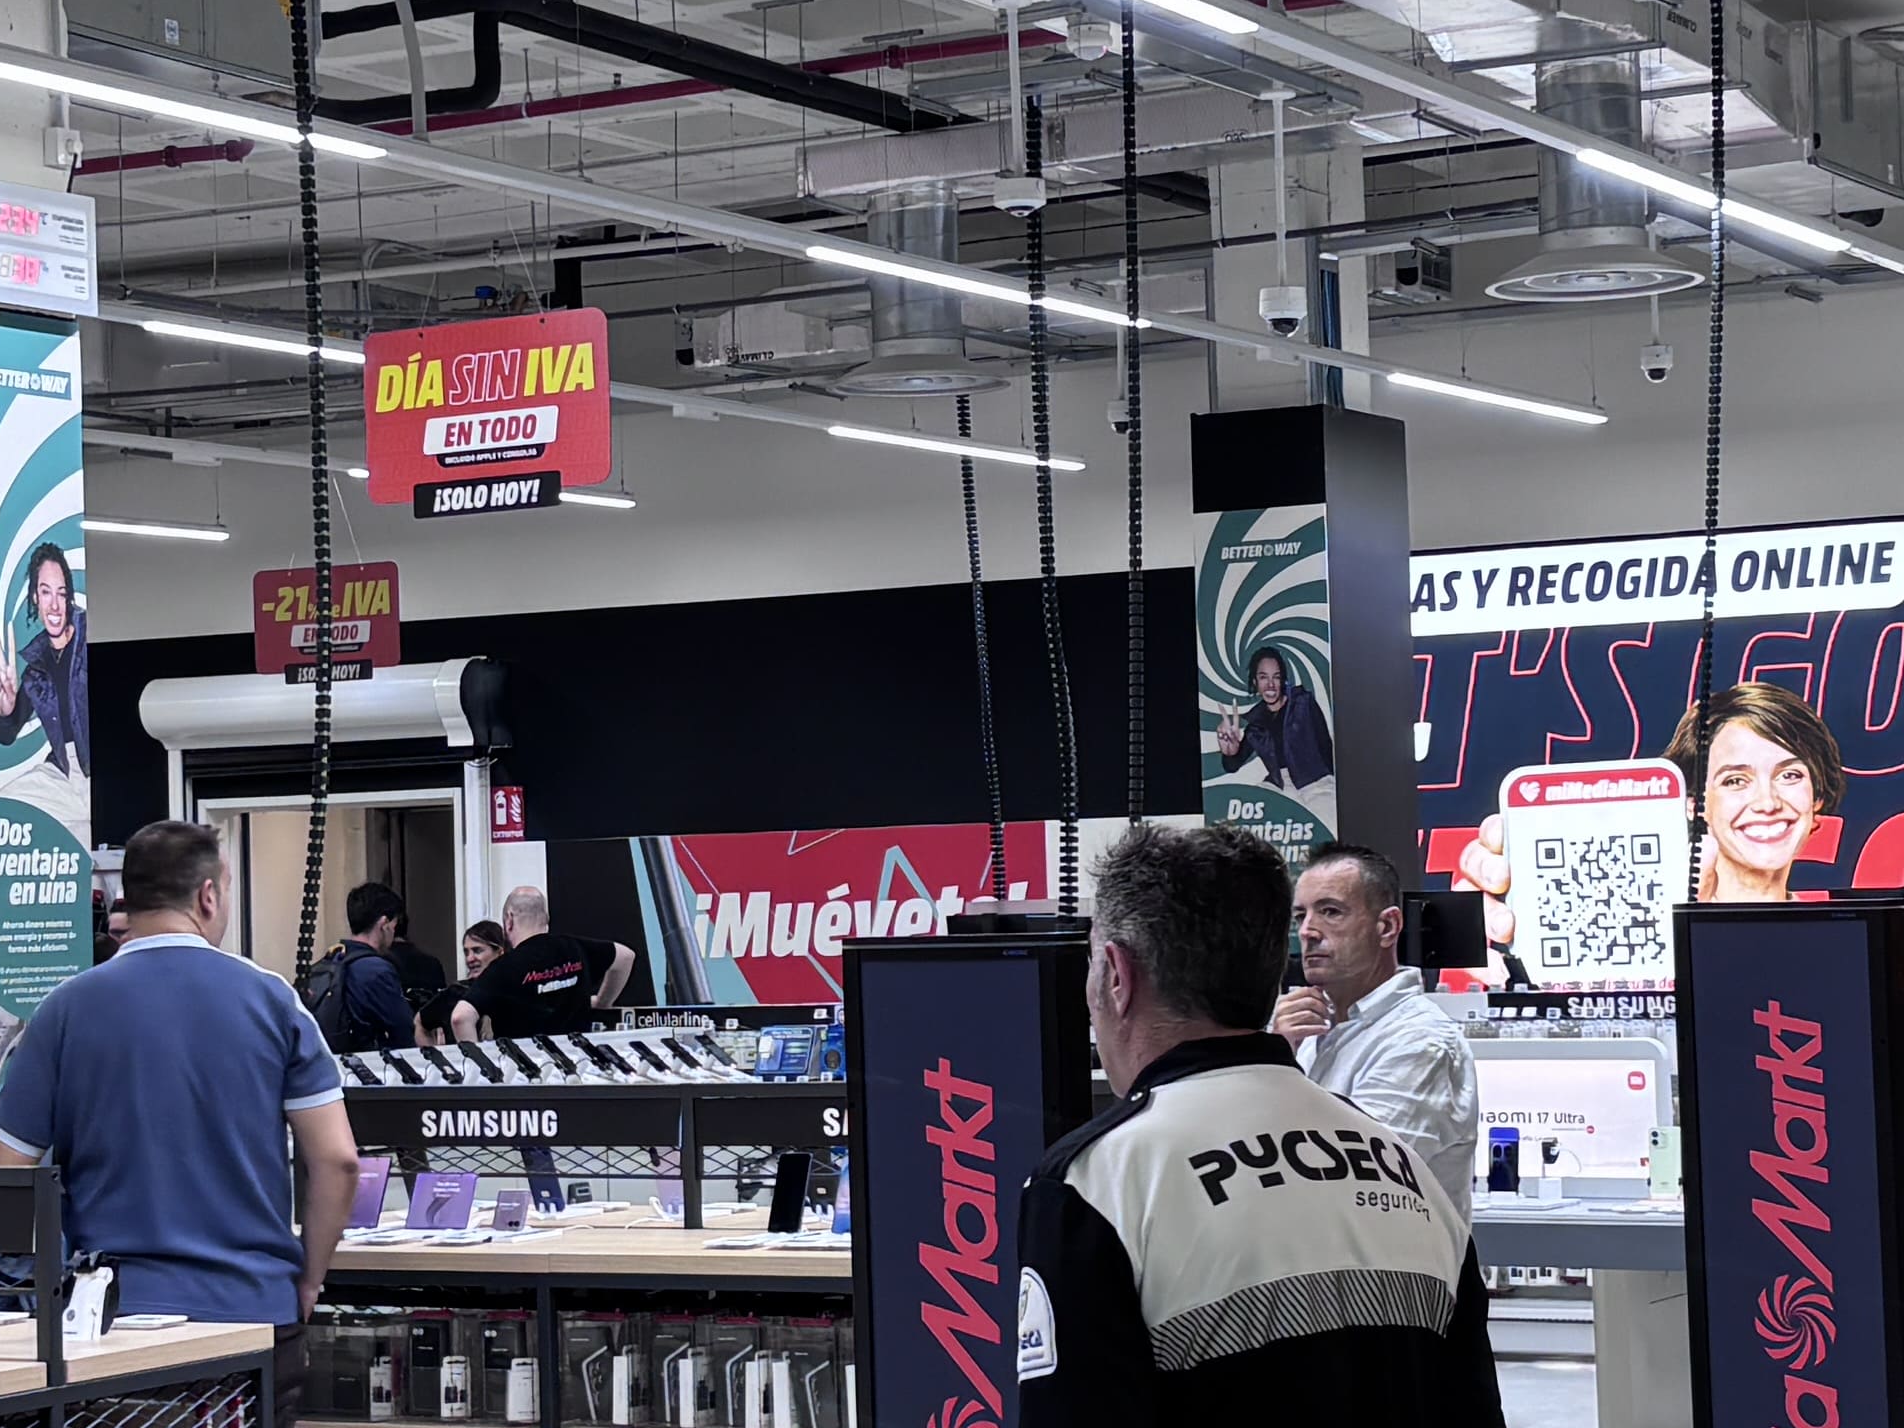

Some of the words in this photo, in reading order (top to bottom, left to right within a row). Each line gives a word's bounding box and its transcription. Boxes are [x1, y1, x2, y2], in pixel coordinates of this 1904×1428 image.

[41, 374, 69, 394] WAY
[375, 352, 444, 413] DÍA
[449, 349, 521, 406] SIN
[523, 342, 595, 397] IVA
[444, 419, 473, 447] EN
[479, 414, 538, 444] TODO
[433, 483, 488, 513] ¡SOLO
[491, 479, 540, 507] HOY!
[1221, 543, 1264, 560] BETTER
[1274, 541, 1302, 558] WAY
[1473, 567, 1498, 608] Y
[1506, 554, 1718, 607] RECOGIDA
[1732, 541, 1897, 593] ONLINE
[342, 579, 392, 618] IVA
[327, 624, 359, 642] ODO
[331, 663, 360, 680] HOY!
[1544, 776, 1671, 803] miMediaMarkt
[1227, 799, 1265, 820] Dos
[1234, 819, 1314, 844] ntajas
[9, 884, 37, 905] en
[39, 879, 77, 904] una
[695, 881, 1028, 959] ¡Muévet
[637, 1010, 709, 1027] cellularline
[1567, 995, 1676, 1019] SAMSUNG
[421, 1109, 558, 1139] SAMSUNG
[1537, 1112, 1549, 1124] 17
[1554, 1112, 1586, 1125] Ultra
[1749, 1000, 1834, 1293] Markt
[1355, 1189, 1431, 1222] seguri
[919, 1057, 1003, 1422] Markt
